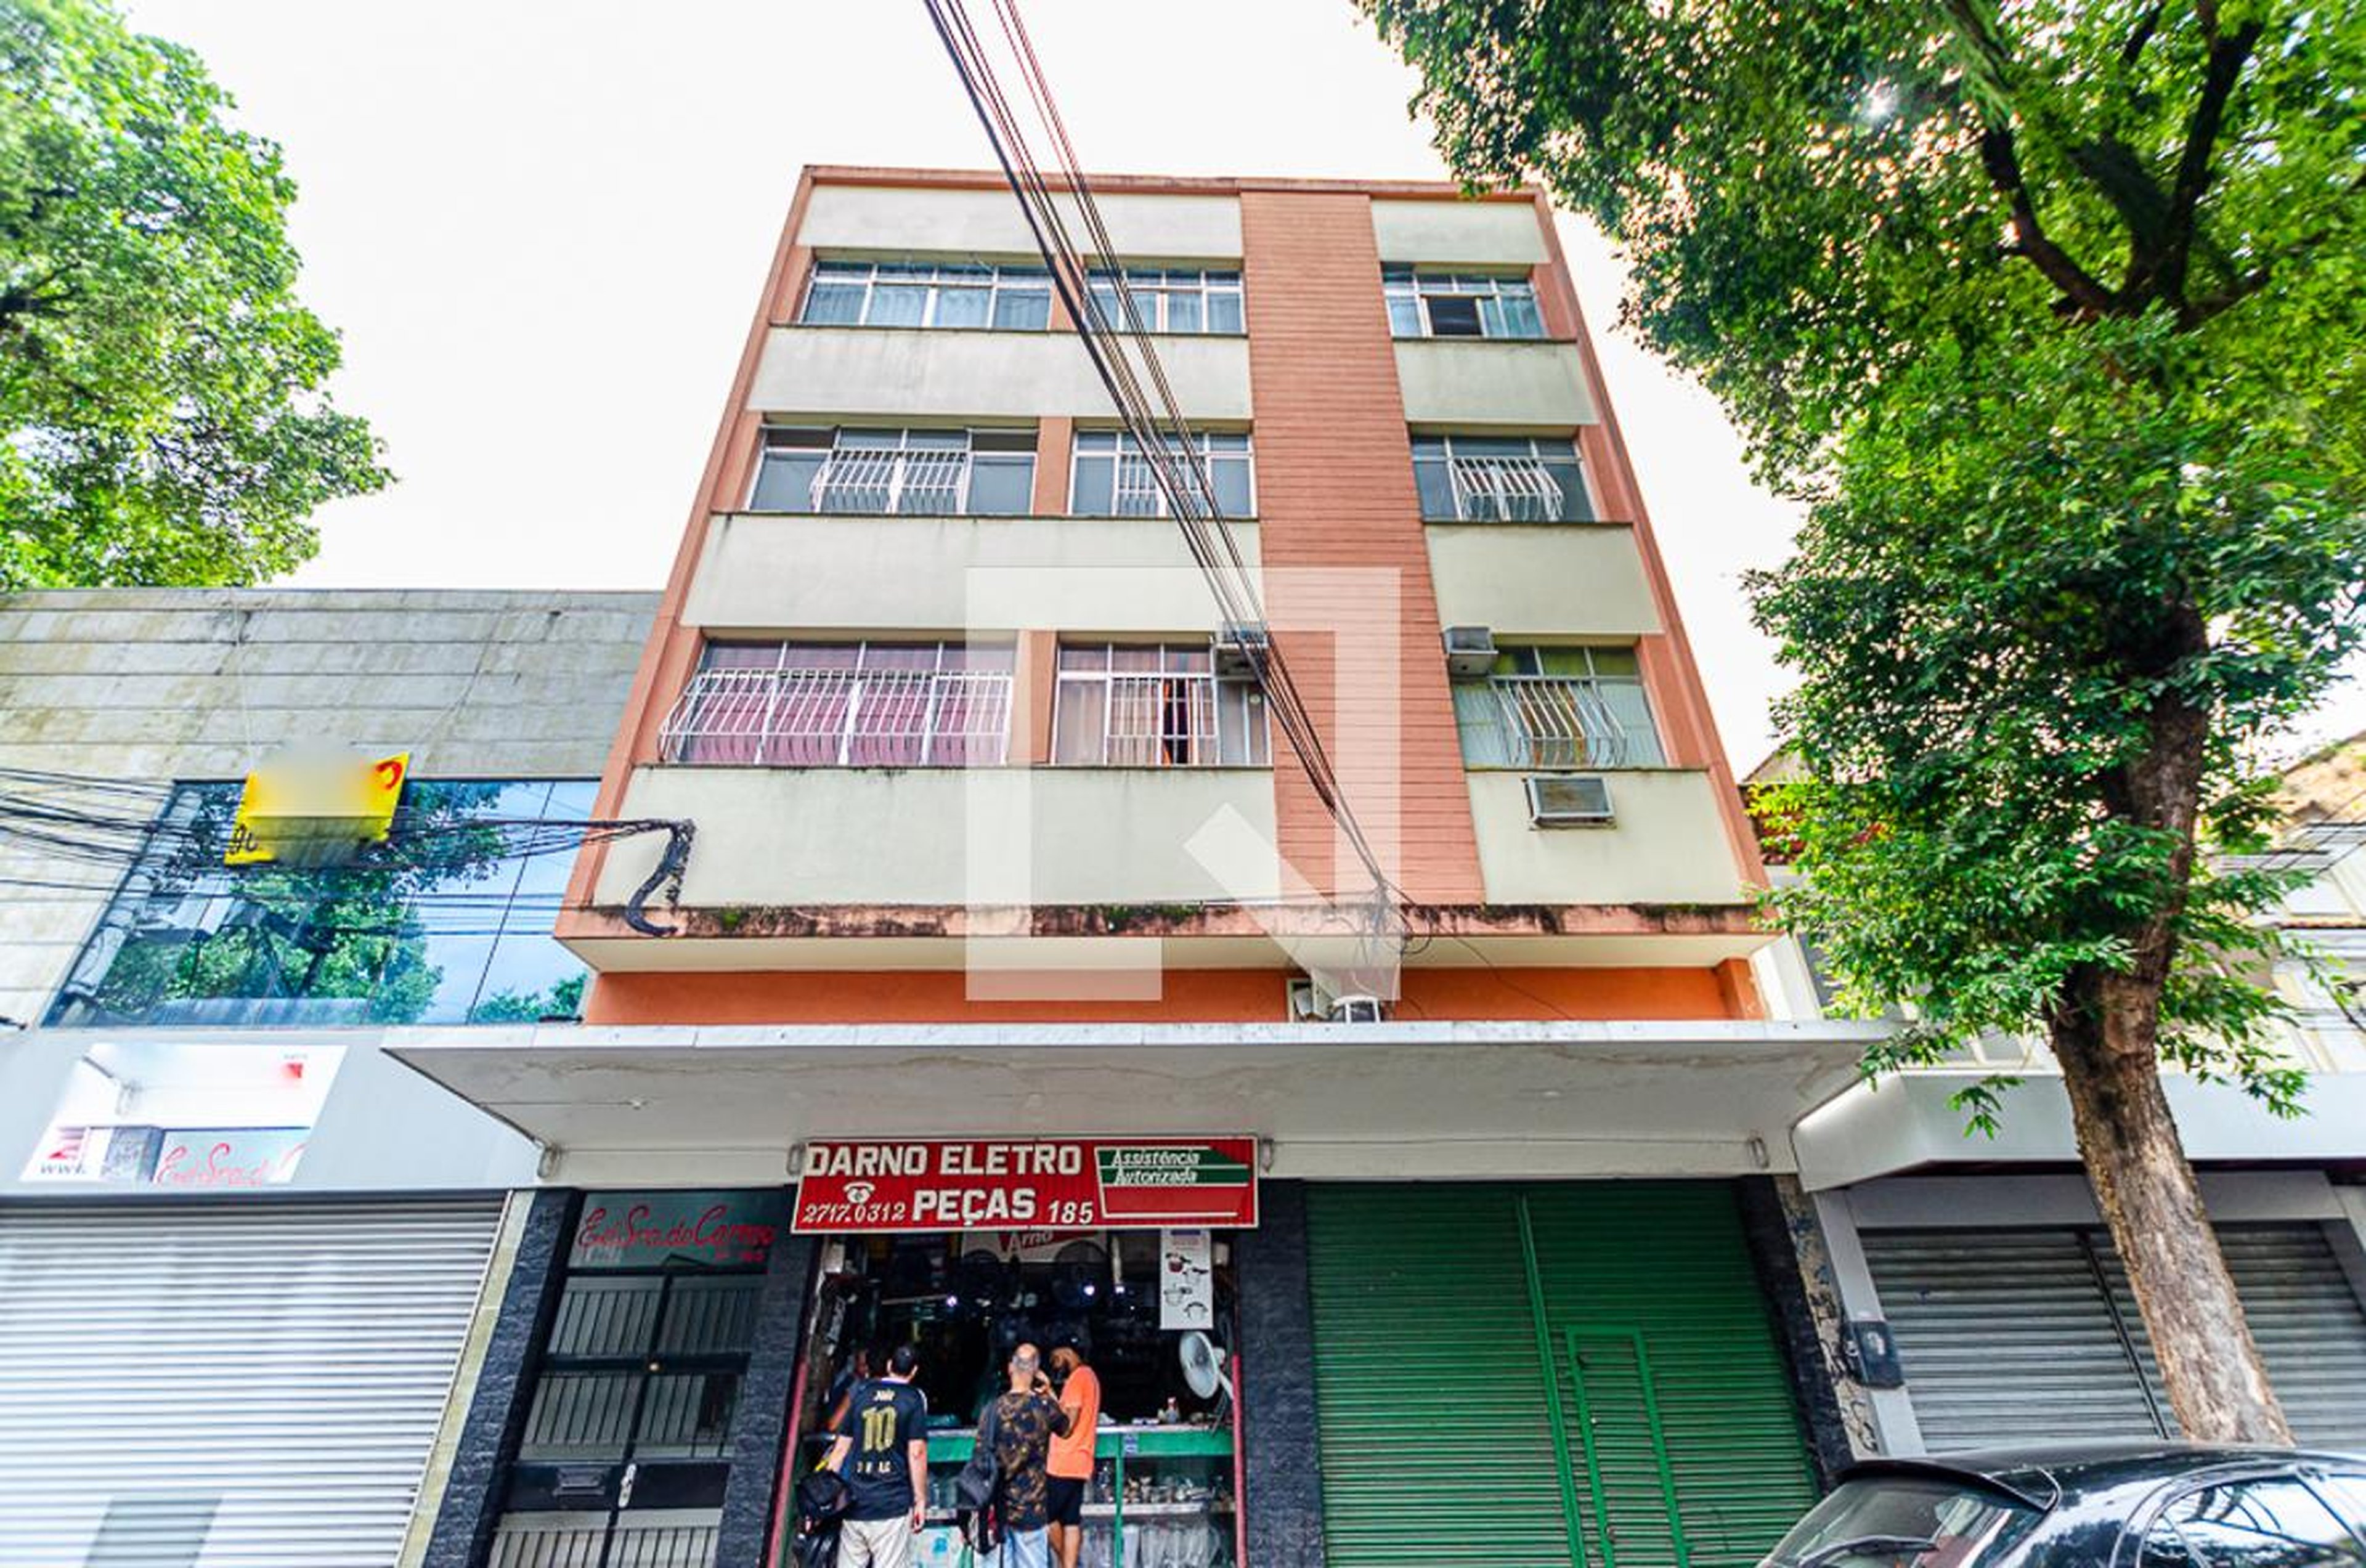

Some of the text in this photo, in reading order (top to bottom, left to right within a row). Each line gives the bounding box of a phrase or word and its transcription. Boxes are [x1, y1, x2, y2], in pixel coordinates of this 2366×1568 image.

[803, 1144, 1081, 1177] DARNO ELETRO
[1112, 1150, 1200, 1167] Assistência
[1114, 1168, 1198, 1184] Autorizada
[802, 1201, 906, 1224] 2717.0312
[912, 1188, 1036, 1226] PEÇAS
[1048, 1200, 1094, 1224] 185
[862, 1406, 896, 1452] 10
